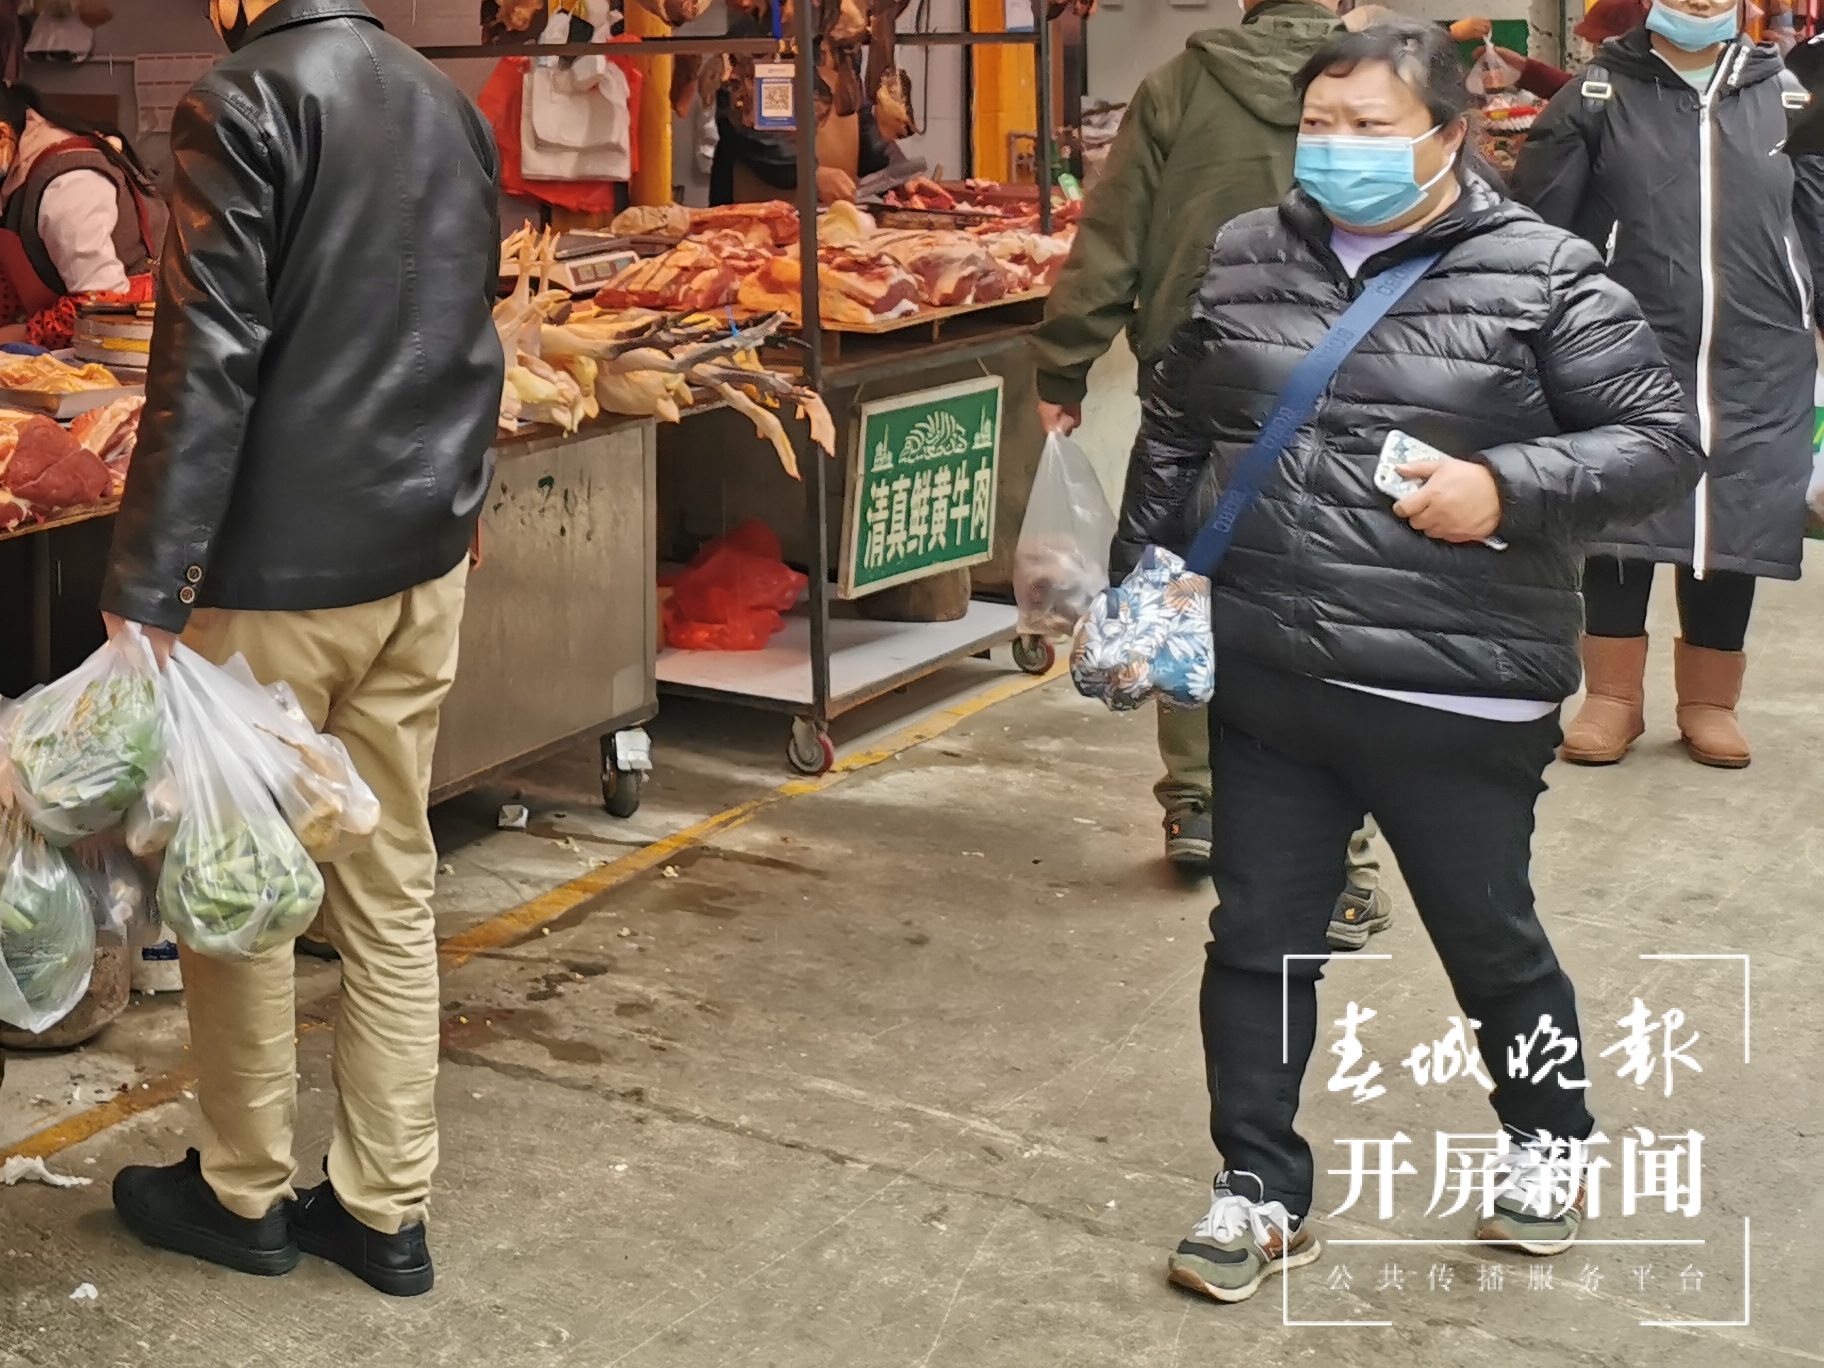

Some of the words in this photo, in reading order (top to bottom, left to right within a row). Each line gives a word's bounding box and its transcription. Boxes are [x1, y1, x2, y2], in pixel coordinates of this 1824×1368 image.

[863, 456, 991, 570] 清真鲜黄牛肉
